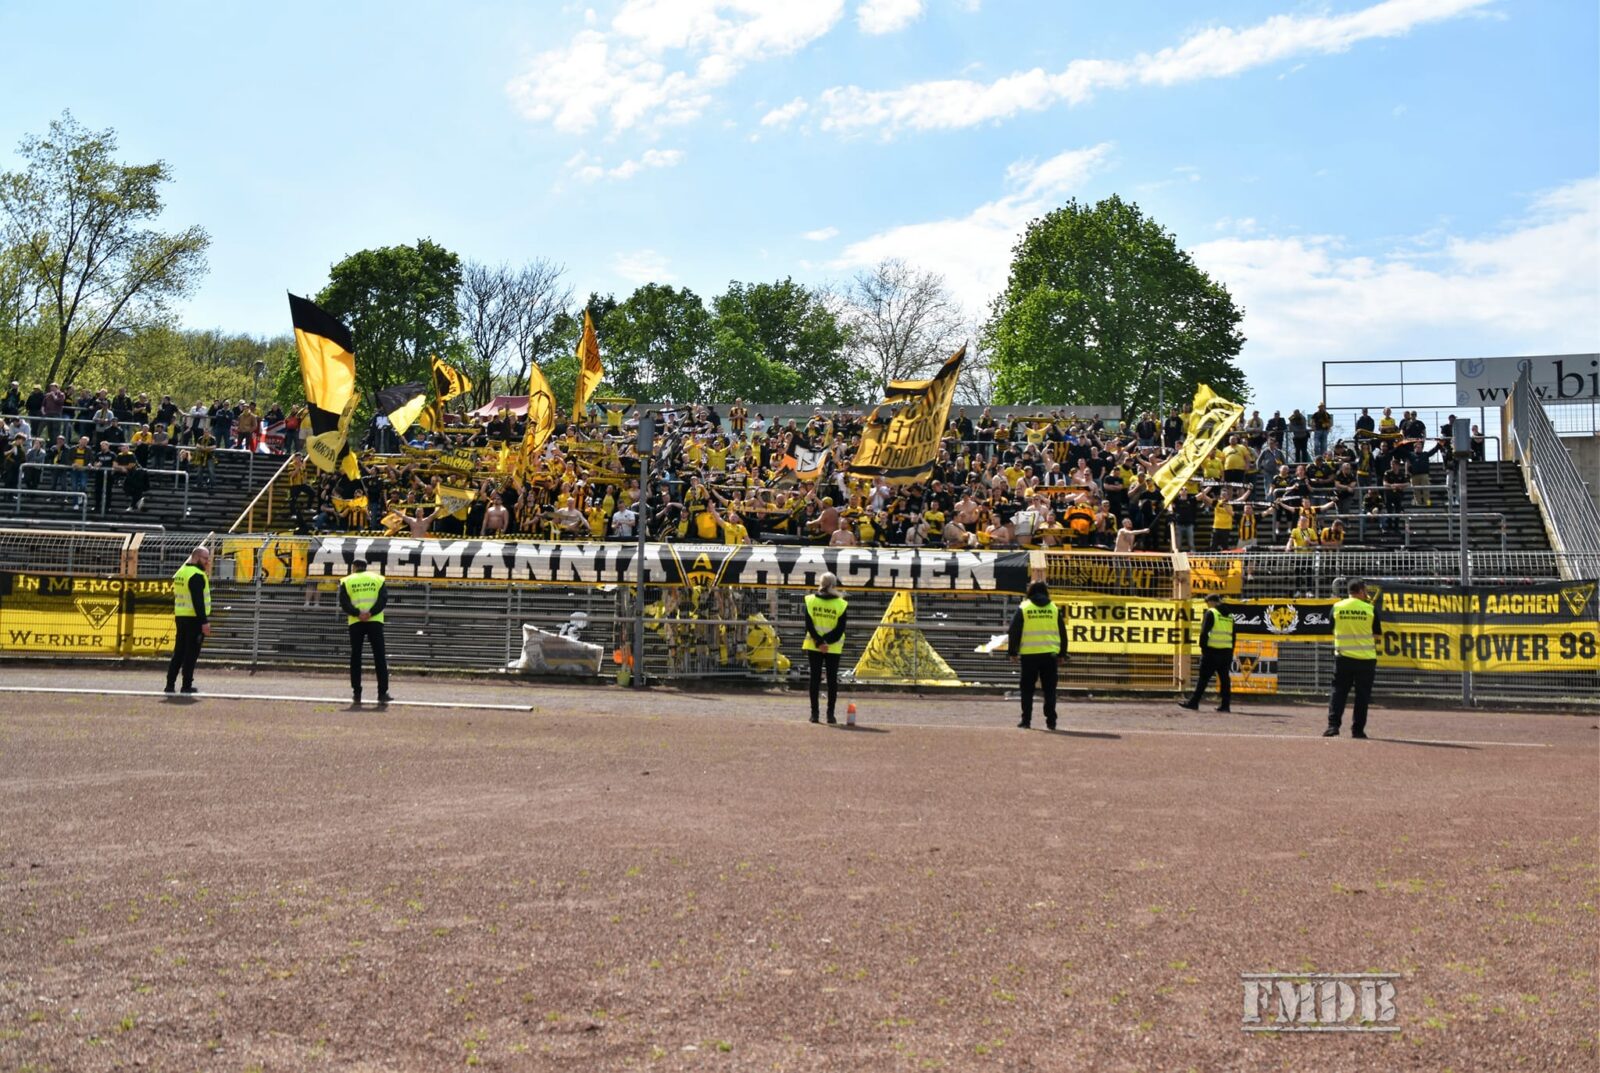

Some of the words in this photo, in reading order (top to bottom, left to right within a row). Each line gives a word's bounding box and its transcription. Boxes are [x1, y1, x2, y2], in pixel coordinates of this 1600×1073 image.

[308, 537, 667, 583] ALEMANNIA
[738, 545, 998, 590] AACHEN
[17, 574, 40, 590] IN
[48, 577, 175, 594] MEMORIAM
[1057, 602, 1206, 622] ÜRTGENWAL
[1381, 592, 1481, 613] ALEMANNIA
[1485, 593, 1560, 614] AACHEN
[9, 630, 104, 647] WERNER
[1072, 625, 1198, 644] RUREIFEL
[1459, 633, 1549, 662] POWER
[1559, 631, 1597, 660] 98
